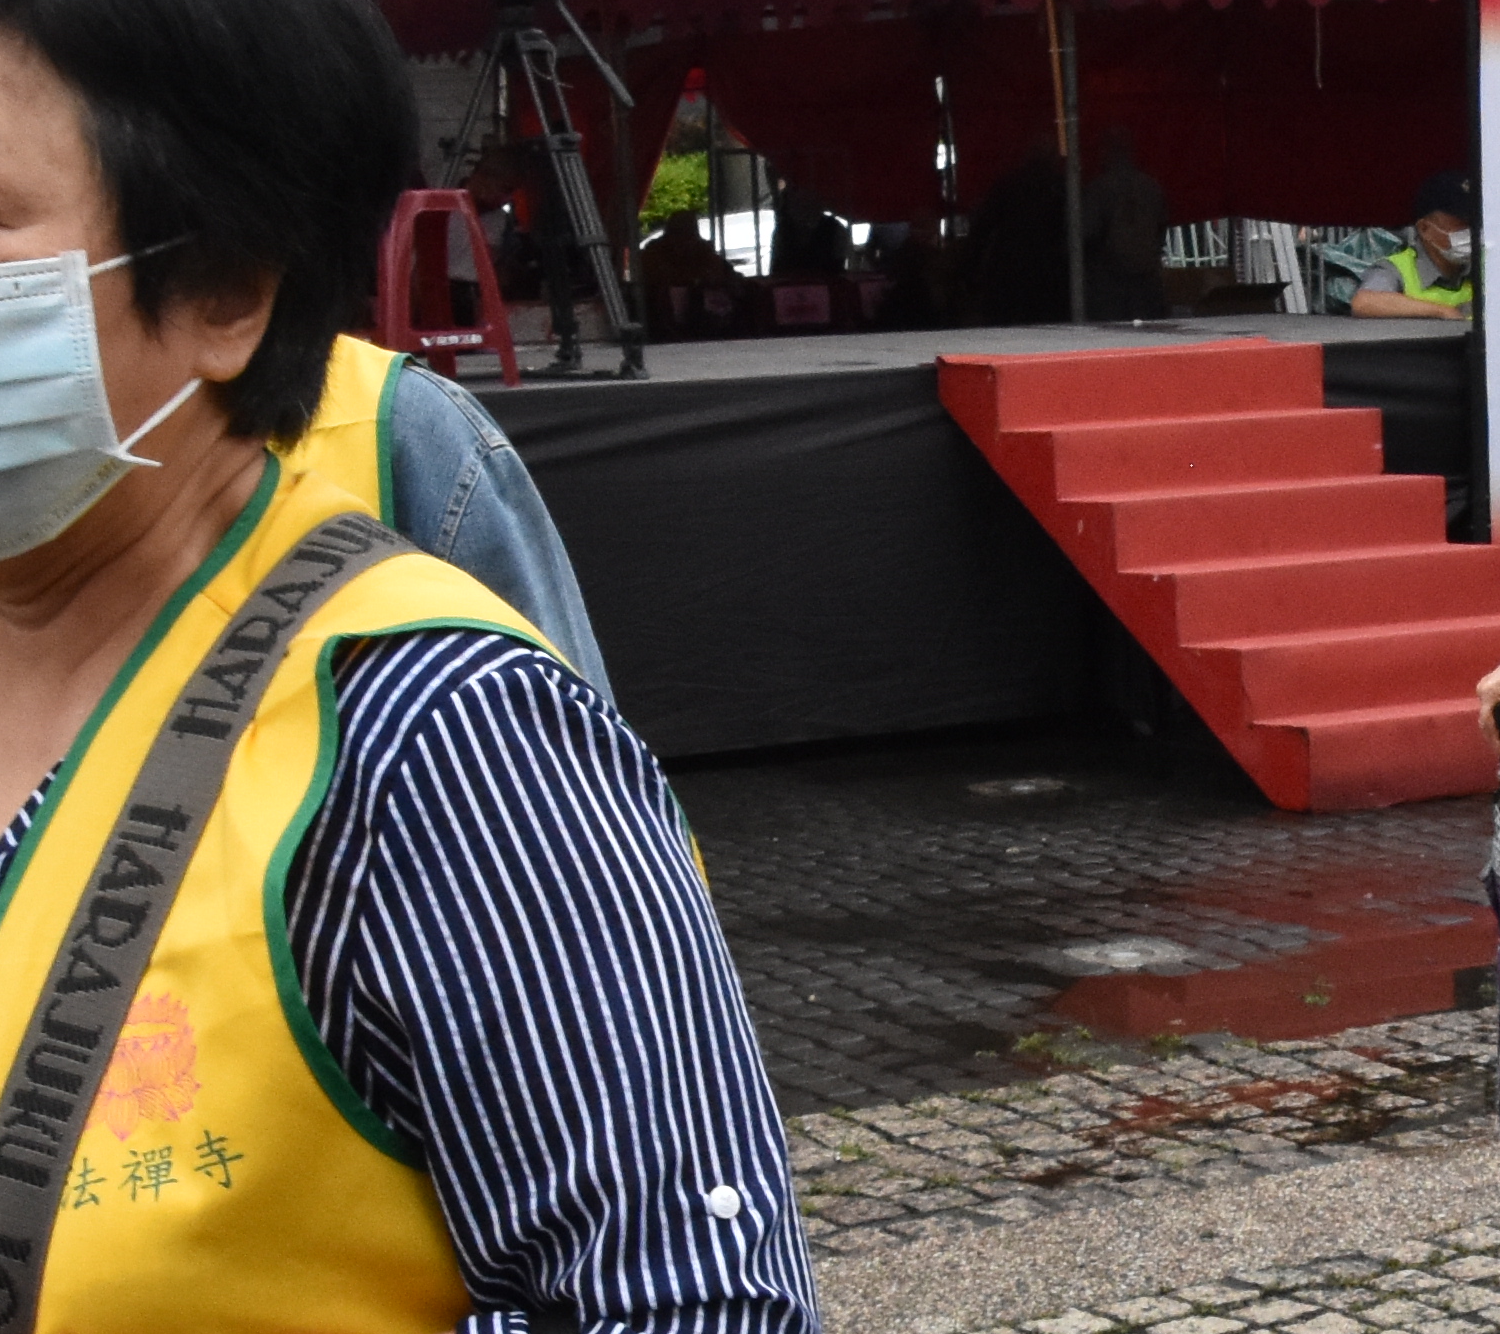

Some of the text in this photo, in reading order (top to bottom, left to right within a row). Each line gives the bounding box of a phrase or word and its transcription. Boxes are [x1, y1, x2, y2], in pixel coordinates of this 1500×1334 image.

[170, 516, 397, 741] HARAJU
[58, 1129, 245, 1210] 法禪寺
